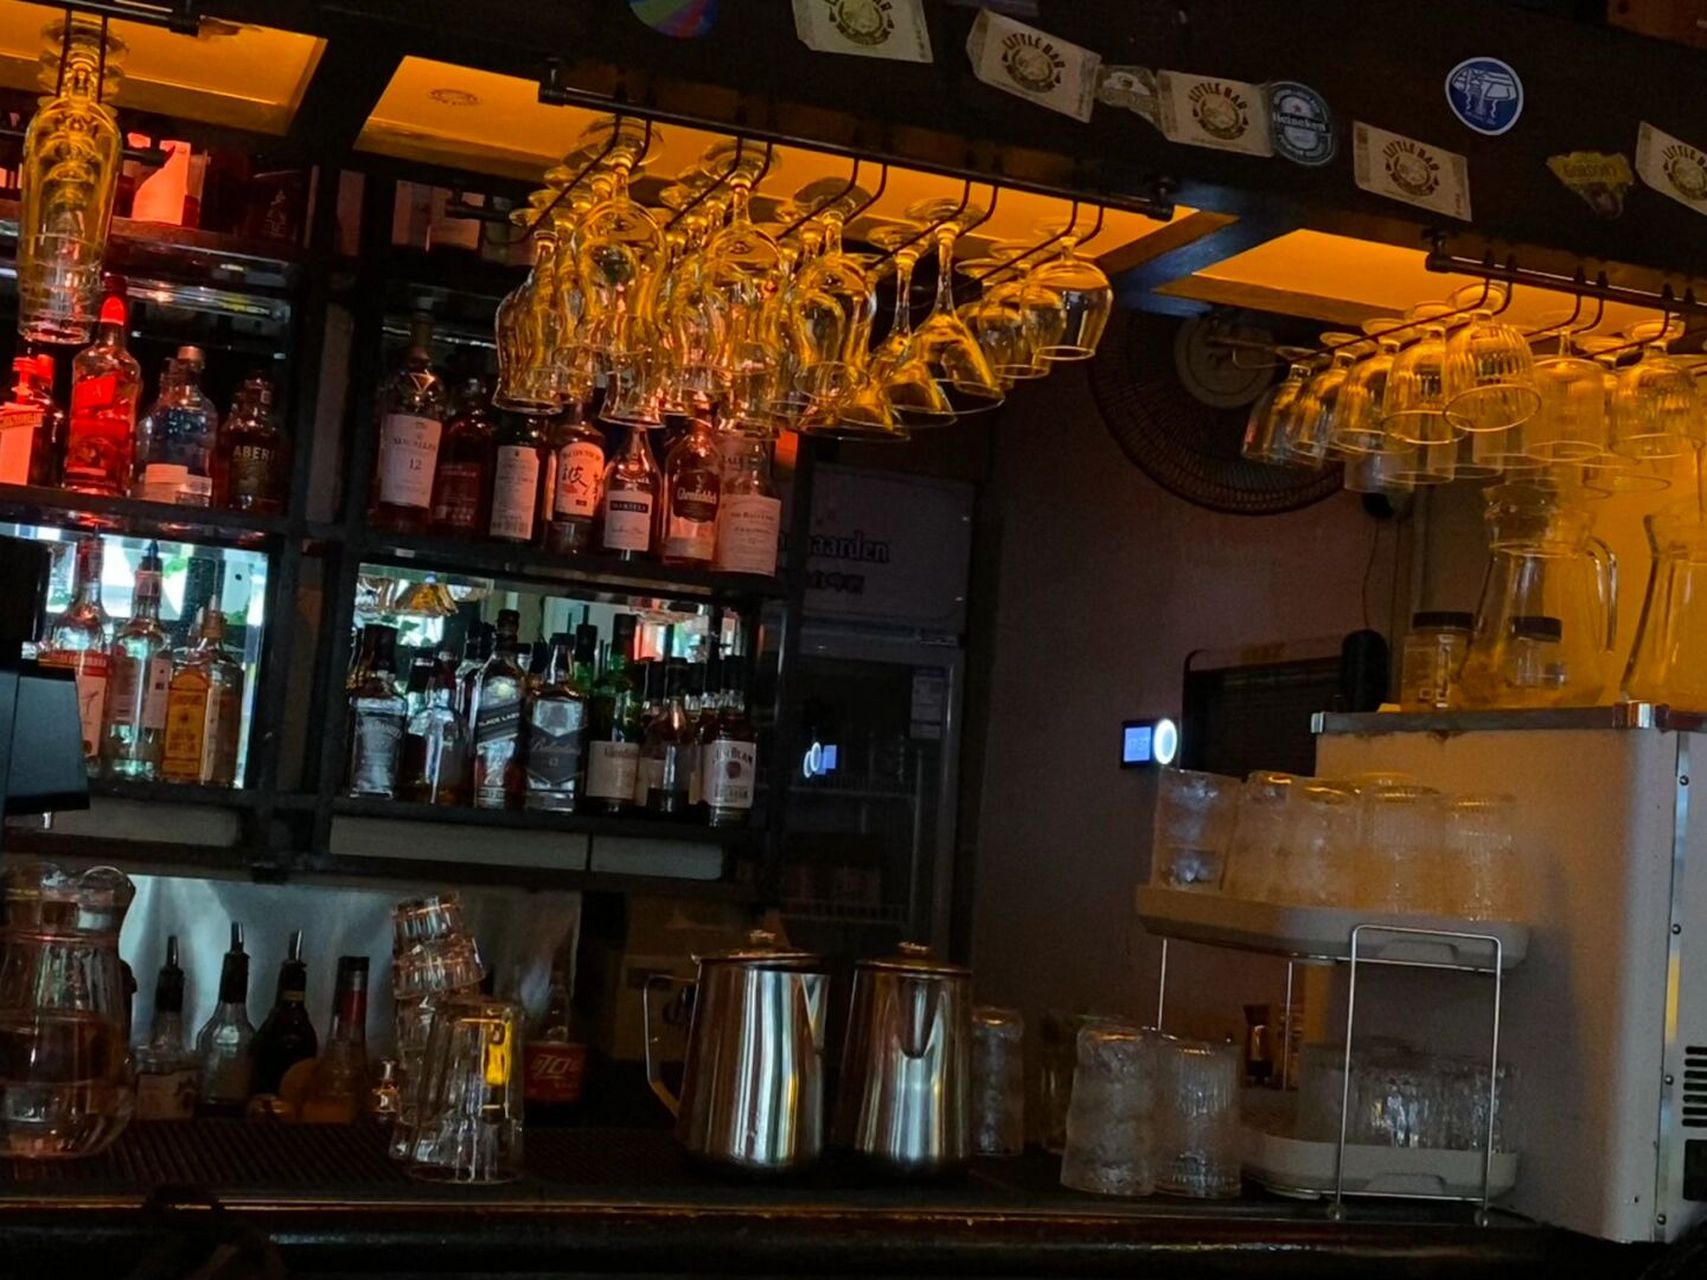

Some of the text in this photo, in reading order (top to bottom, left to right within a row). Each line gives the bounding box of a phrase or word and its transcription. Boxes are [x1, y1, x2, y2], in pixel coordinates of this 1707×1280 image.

[1002, 33, 1065, 69] LITTLE BAR
[1188, 82, 1248, 110] LITTLE BAR
[1382, 140, 1440, 171] LITTLE BAR
[1661, 144, 1696, 161] LITTLE
[409, 457, 422, 471] 12
